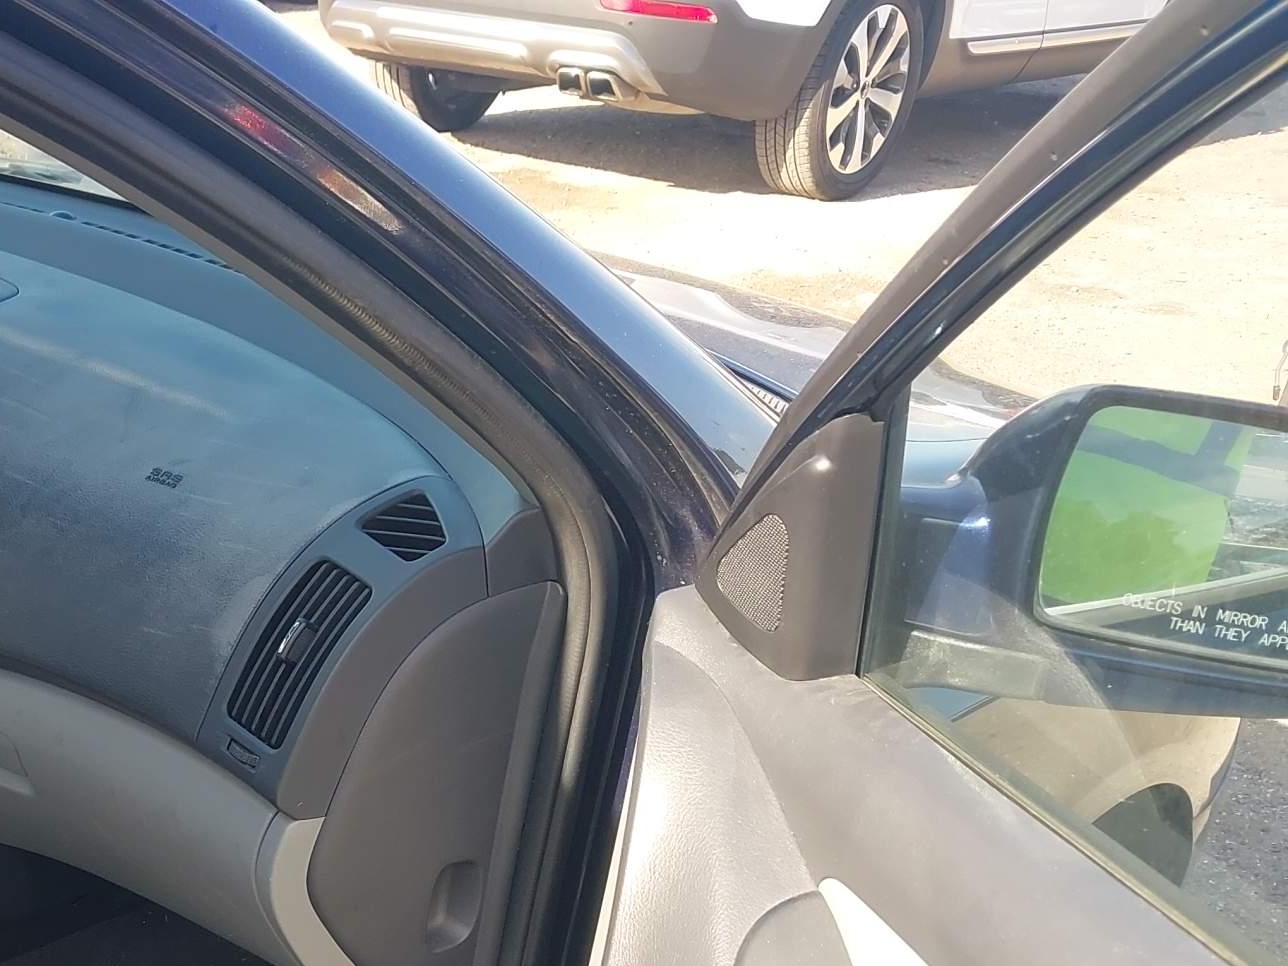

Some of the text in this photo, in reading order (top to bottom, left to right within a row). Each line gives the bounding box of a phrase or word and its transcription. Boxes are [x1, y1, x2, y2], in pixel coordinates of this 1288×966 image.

[150, 467, 184, 483] SRS
[1121, 592, 1183, 615] OBJECTS
[1192, 604, 1208, 619] IN
[1215, 608, 1269, 630] MIRROR
[1169, 616, 1206, 635] THAN
[1214, 624, 1251, 642] THEY
